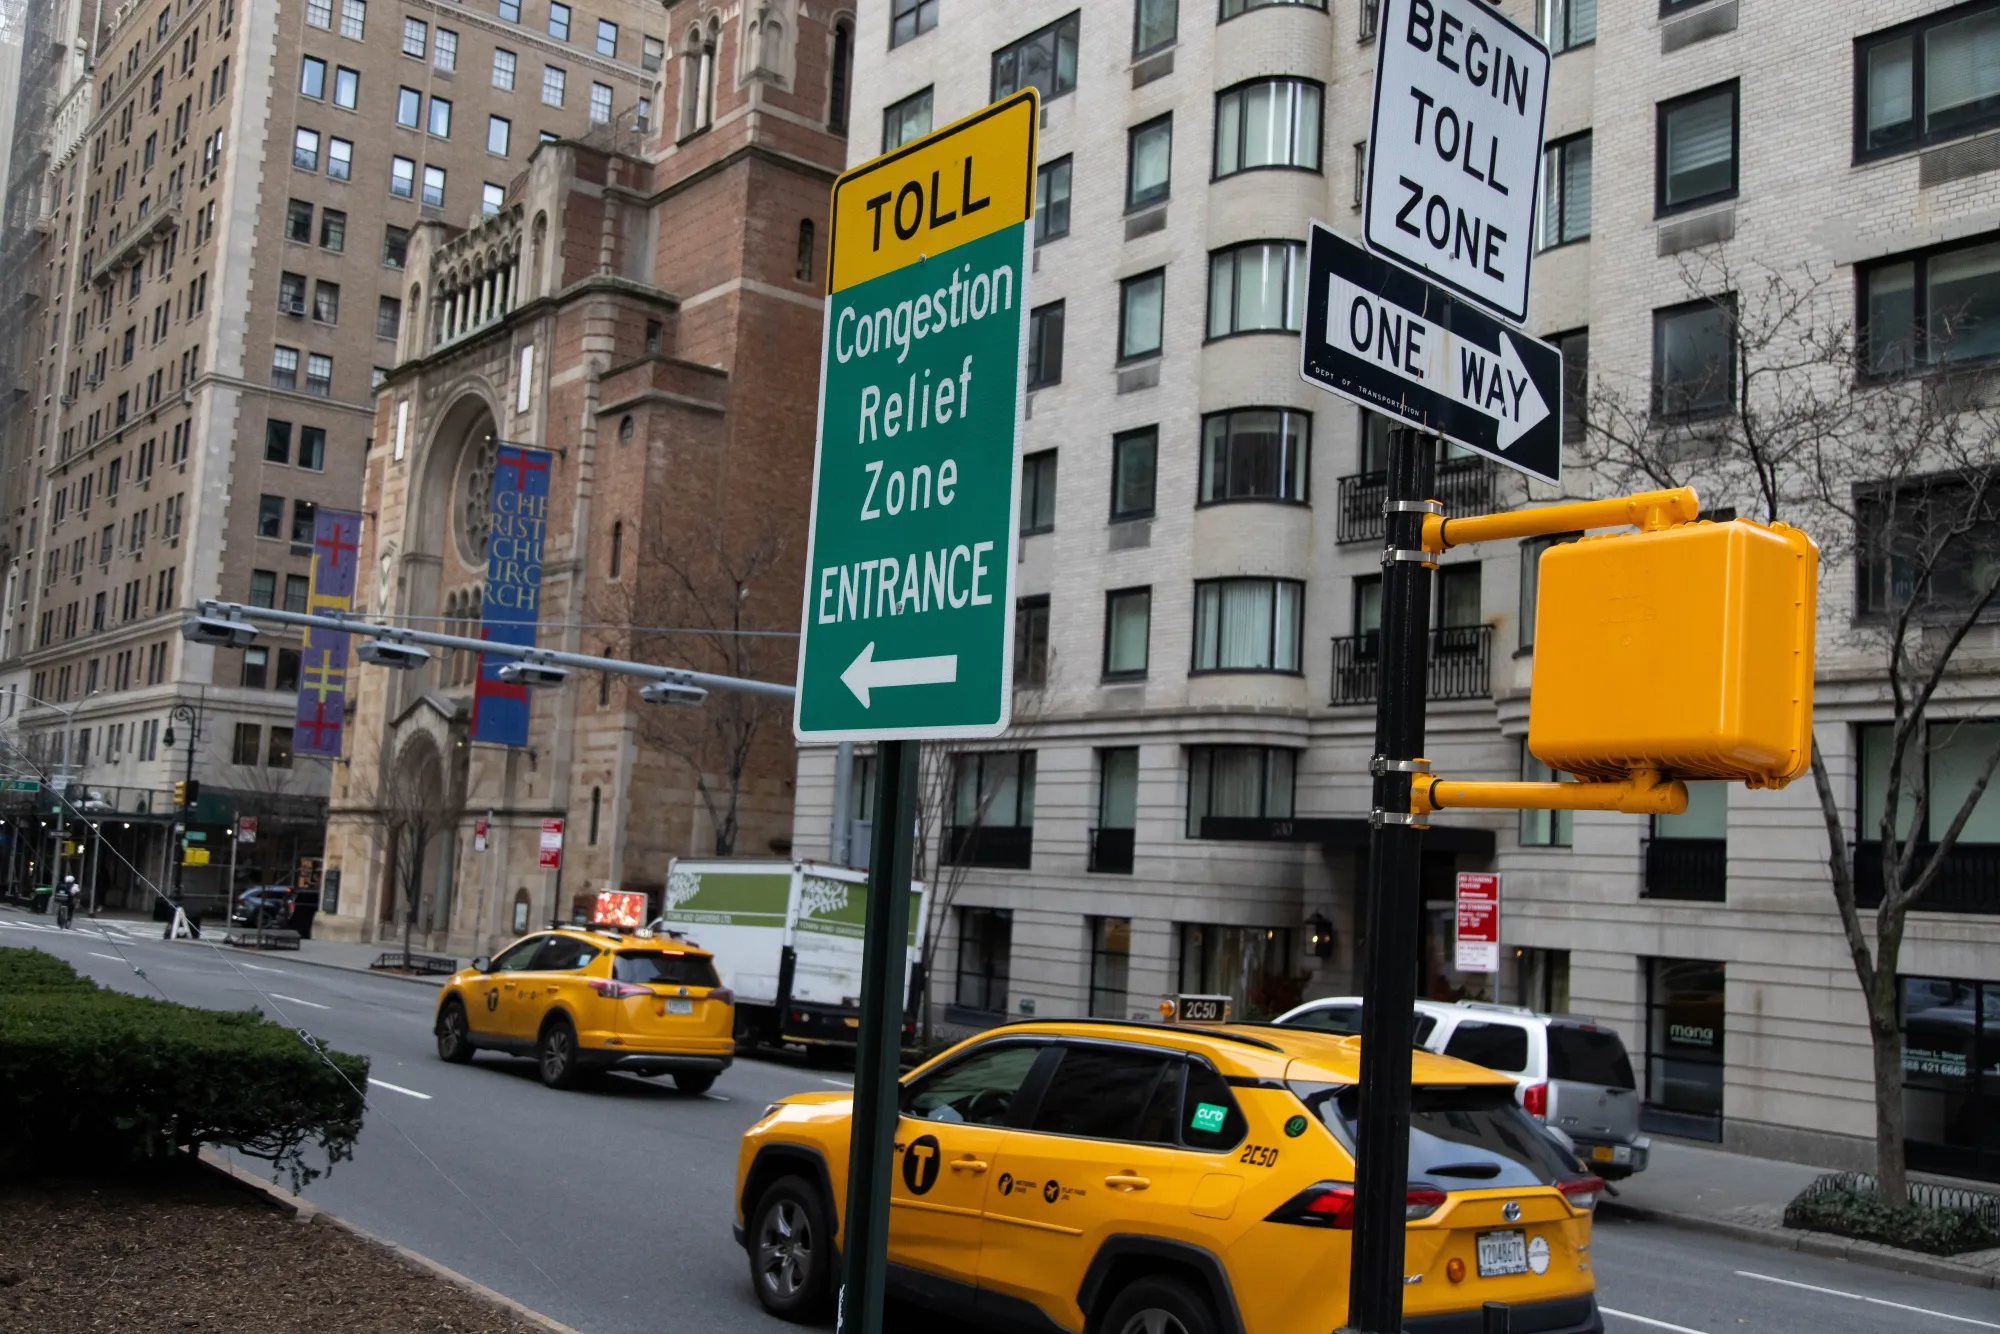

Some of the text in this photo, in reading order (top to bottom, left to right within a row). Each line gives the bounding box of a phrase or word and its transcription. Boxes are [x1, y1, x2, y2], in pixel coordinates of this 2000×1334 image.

[1407, 0, 1529, 116] BEGIN
[1410, 85, 1509, 197] TOLL
[866, 155, 991, 252] TOLL
[1395, 174, 1507, 283] ZONE
[836, 263, 1013, 364] Congestion
[858, 355, 973, 444] Relief
[1315, 366, 1420, 416] DEPT OF TRANSPORTATION
[1350, 295, 1528, 423] ONE WAY
[860, 458, 958, 521] Zone
[818, 540, 994, 624] ENTRANCE
[836, 927, 865, 937] GARDEN
[1186, 1001, 1217, 1019] 2C50
[1921, 1062, 1939, 1073] 421
[1197, 1108, 1224, 1122] curb
[1240, 1144, 1279, 1168] 2C50
